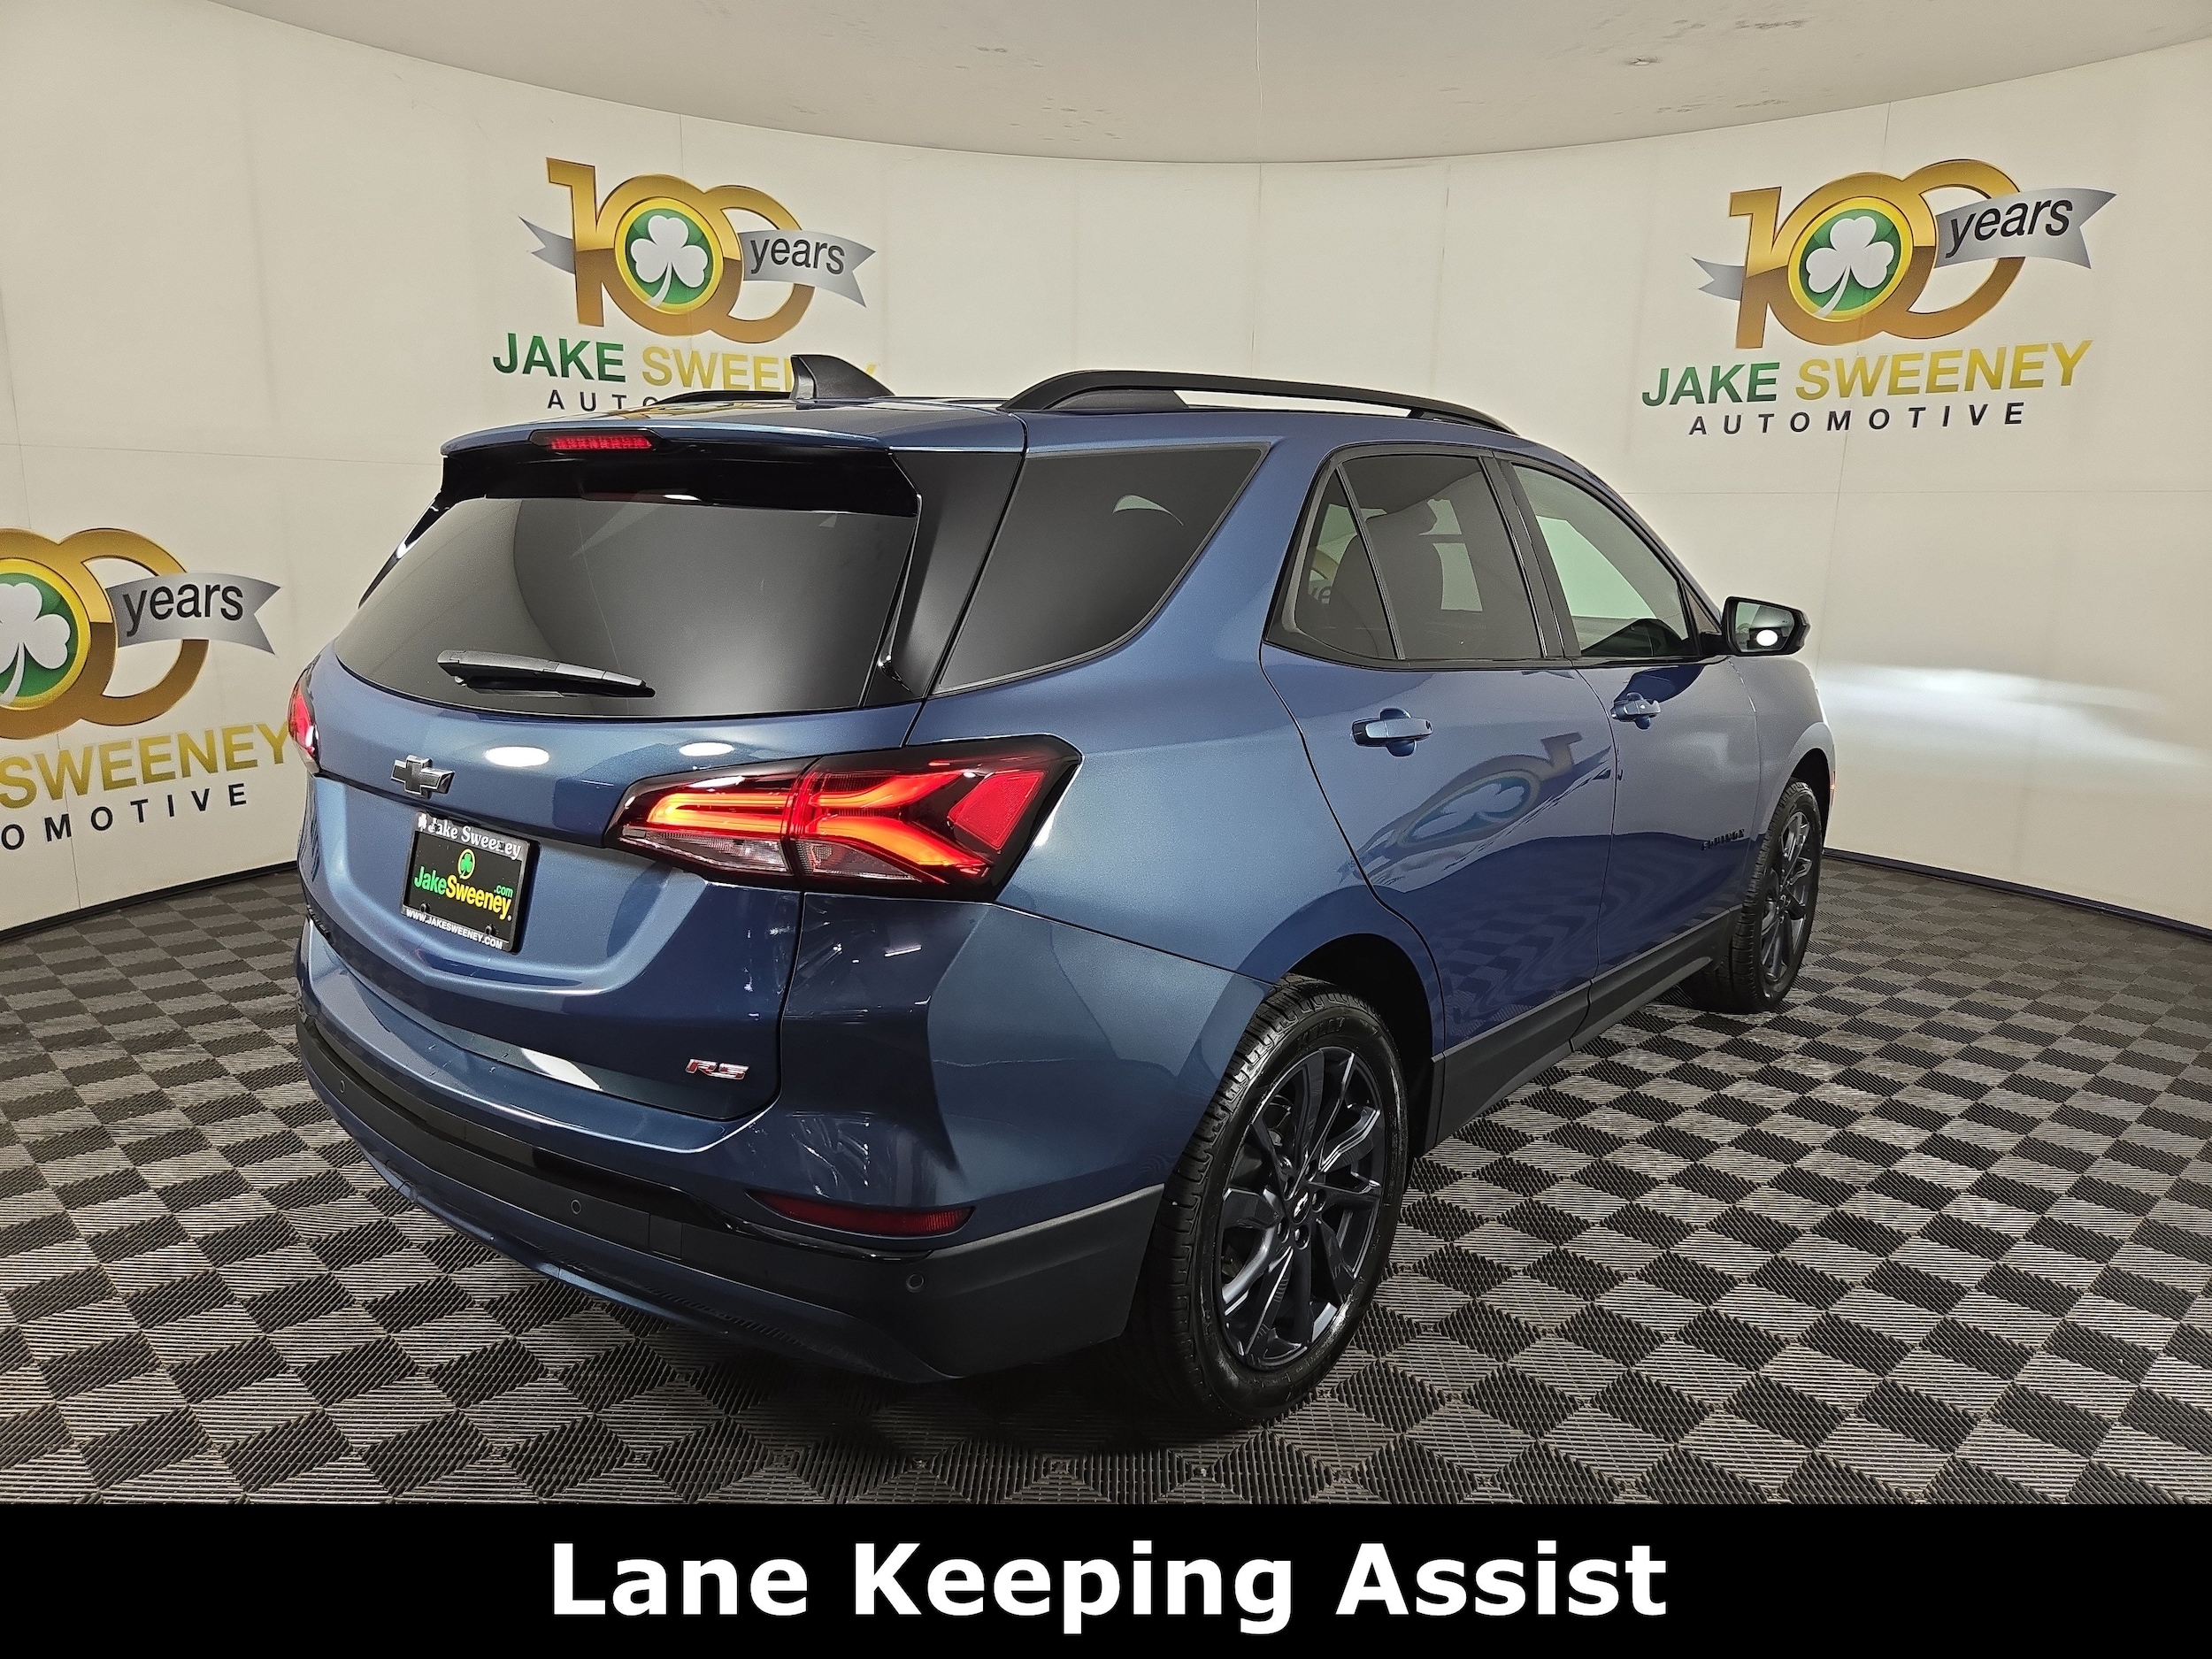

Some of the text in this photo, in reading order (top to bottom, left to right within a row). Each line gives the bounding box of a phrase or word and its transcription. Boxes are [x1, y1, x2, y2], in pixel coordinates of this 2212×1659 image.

[1945, 197, 2073, 259] years
[749, 237, 846, 276] years
[492, 333, 879, 391] JAKE SWEE
[1641, 339, 2093, 407] JAKE SWEENEY
[1688, 403, 2025, 436] AUTOMOTIVE
[122, 583, 244, 637] years
[0, 723, 289, 810] SWEENEY
[427, 817, 522, 861] Jake Sweeney
[493, 885, 514, 898] .com
[406, 908, 503, 950] WWW.JAKESWEENEY.COM
[685, 1058, 750, 1080] RS
